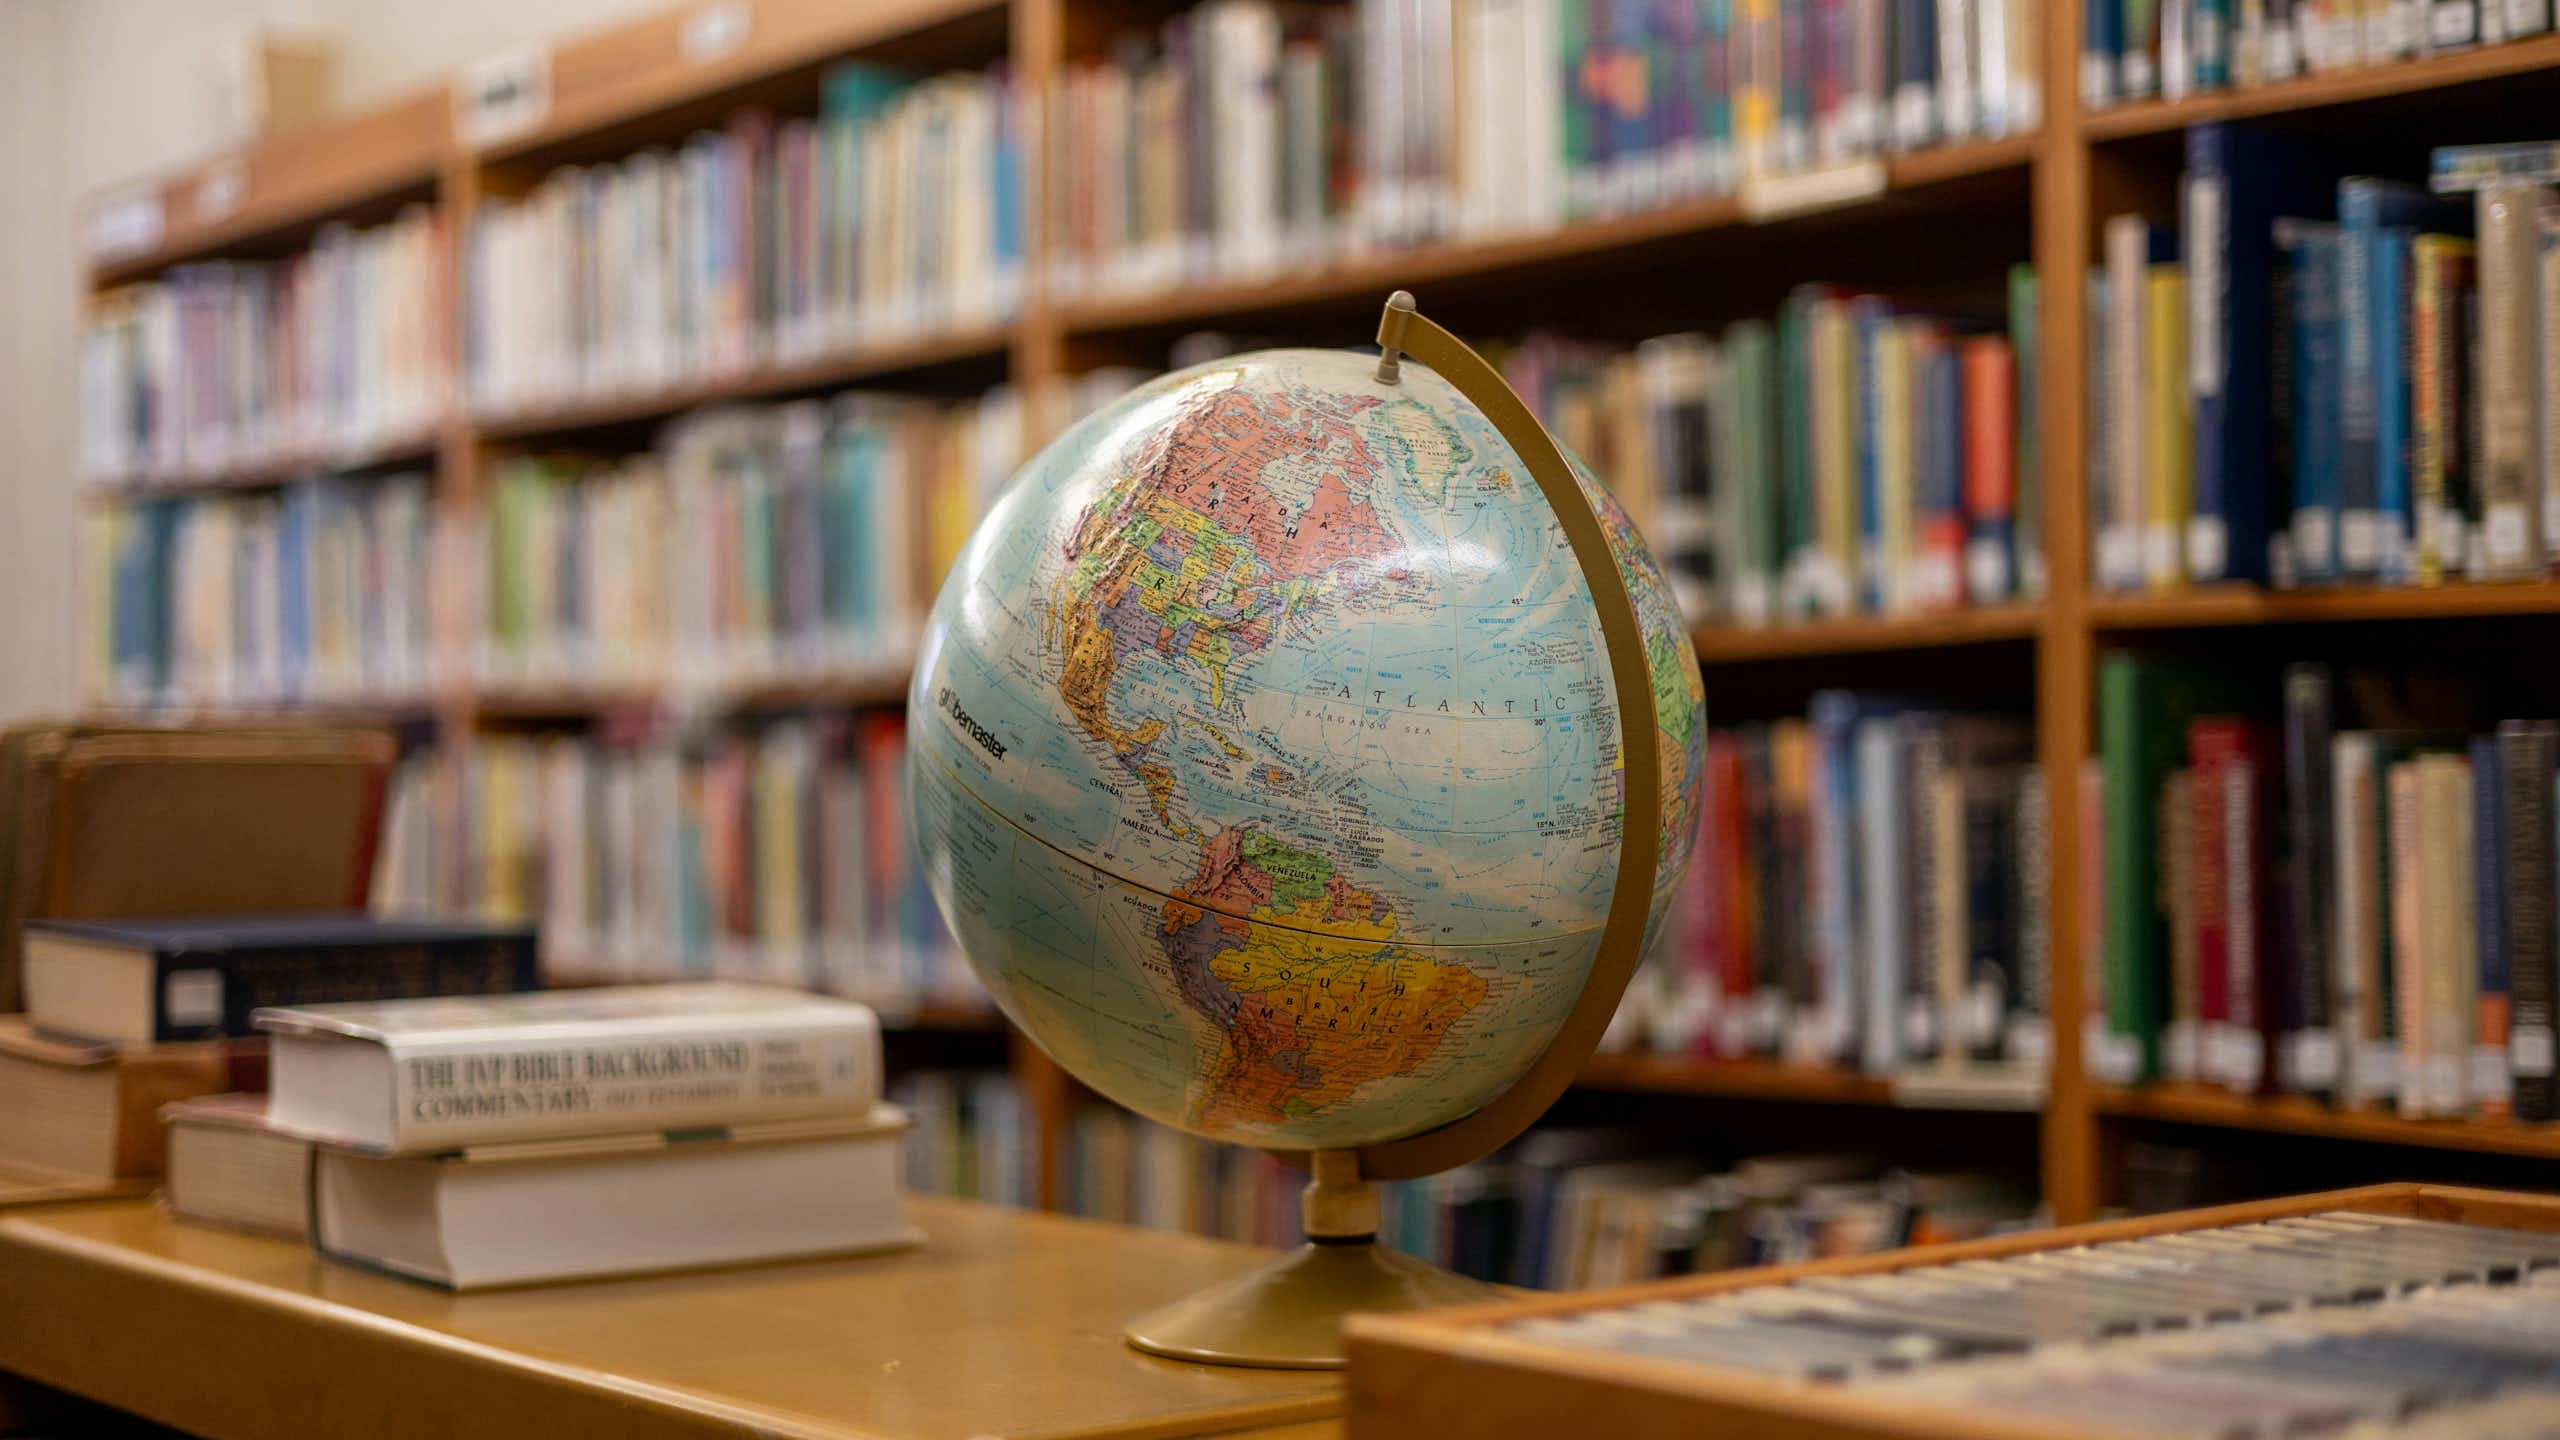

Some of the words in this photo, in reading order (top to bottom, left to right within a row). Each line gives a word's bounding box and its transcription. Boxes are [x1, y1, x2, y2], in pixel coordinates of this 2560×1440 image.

[1528, 658, 1557, 666] AZORES
[1138, 661, 1169, 677] GULF
[1179, 677, 1196, 689] OF
[1129, 683, 1187, 710] MEXICO
[1337, 685, 1566, 716] ATLANTIC
[1304, 709, 1387, 730] SARGASSO
[1404, 726, 1432, 736] SEA
[1534, 718, 1547, 727] 30°
[1256, 733, 1287, 758] BAHAMAS
[1191, 757, 1221, 769] JAMAICA
[1089, 778, 1123, 800] CENTRAL
[1120, 816, 1160, 837] AMERICA
[1338, 816, 1370, 826] DOMINICA
[1348, 833, 1385, 844] BARBADOS
[1350, 850, 1380, 858] TRINIDAD
[1232, 863, 1265, 901] COLOMBIA
[1266, 863, 1317, 882] VENEZUELA
[1123, 895, 1158, 913] ECUADOR
[1142, 960, 1168, 976] PERU
[1243, 961, 1406, 997] SOUTH
[1229, 1000, 1433, 1034] AMERICA
[1286, 996, 1430, 1019] BRAZIL
[408, 1056, 454, 1090] THE
[583, 1039, 750, 1082] BACKGROUND
[412, 1086, 592, 1122] COMMENTARY
